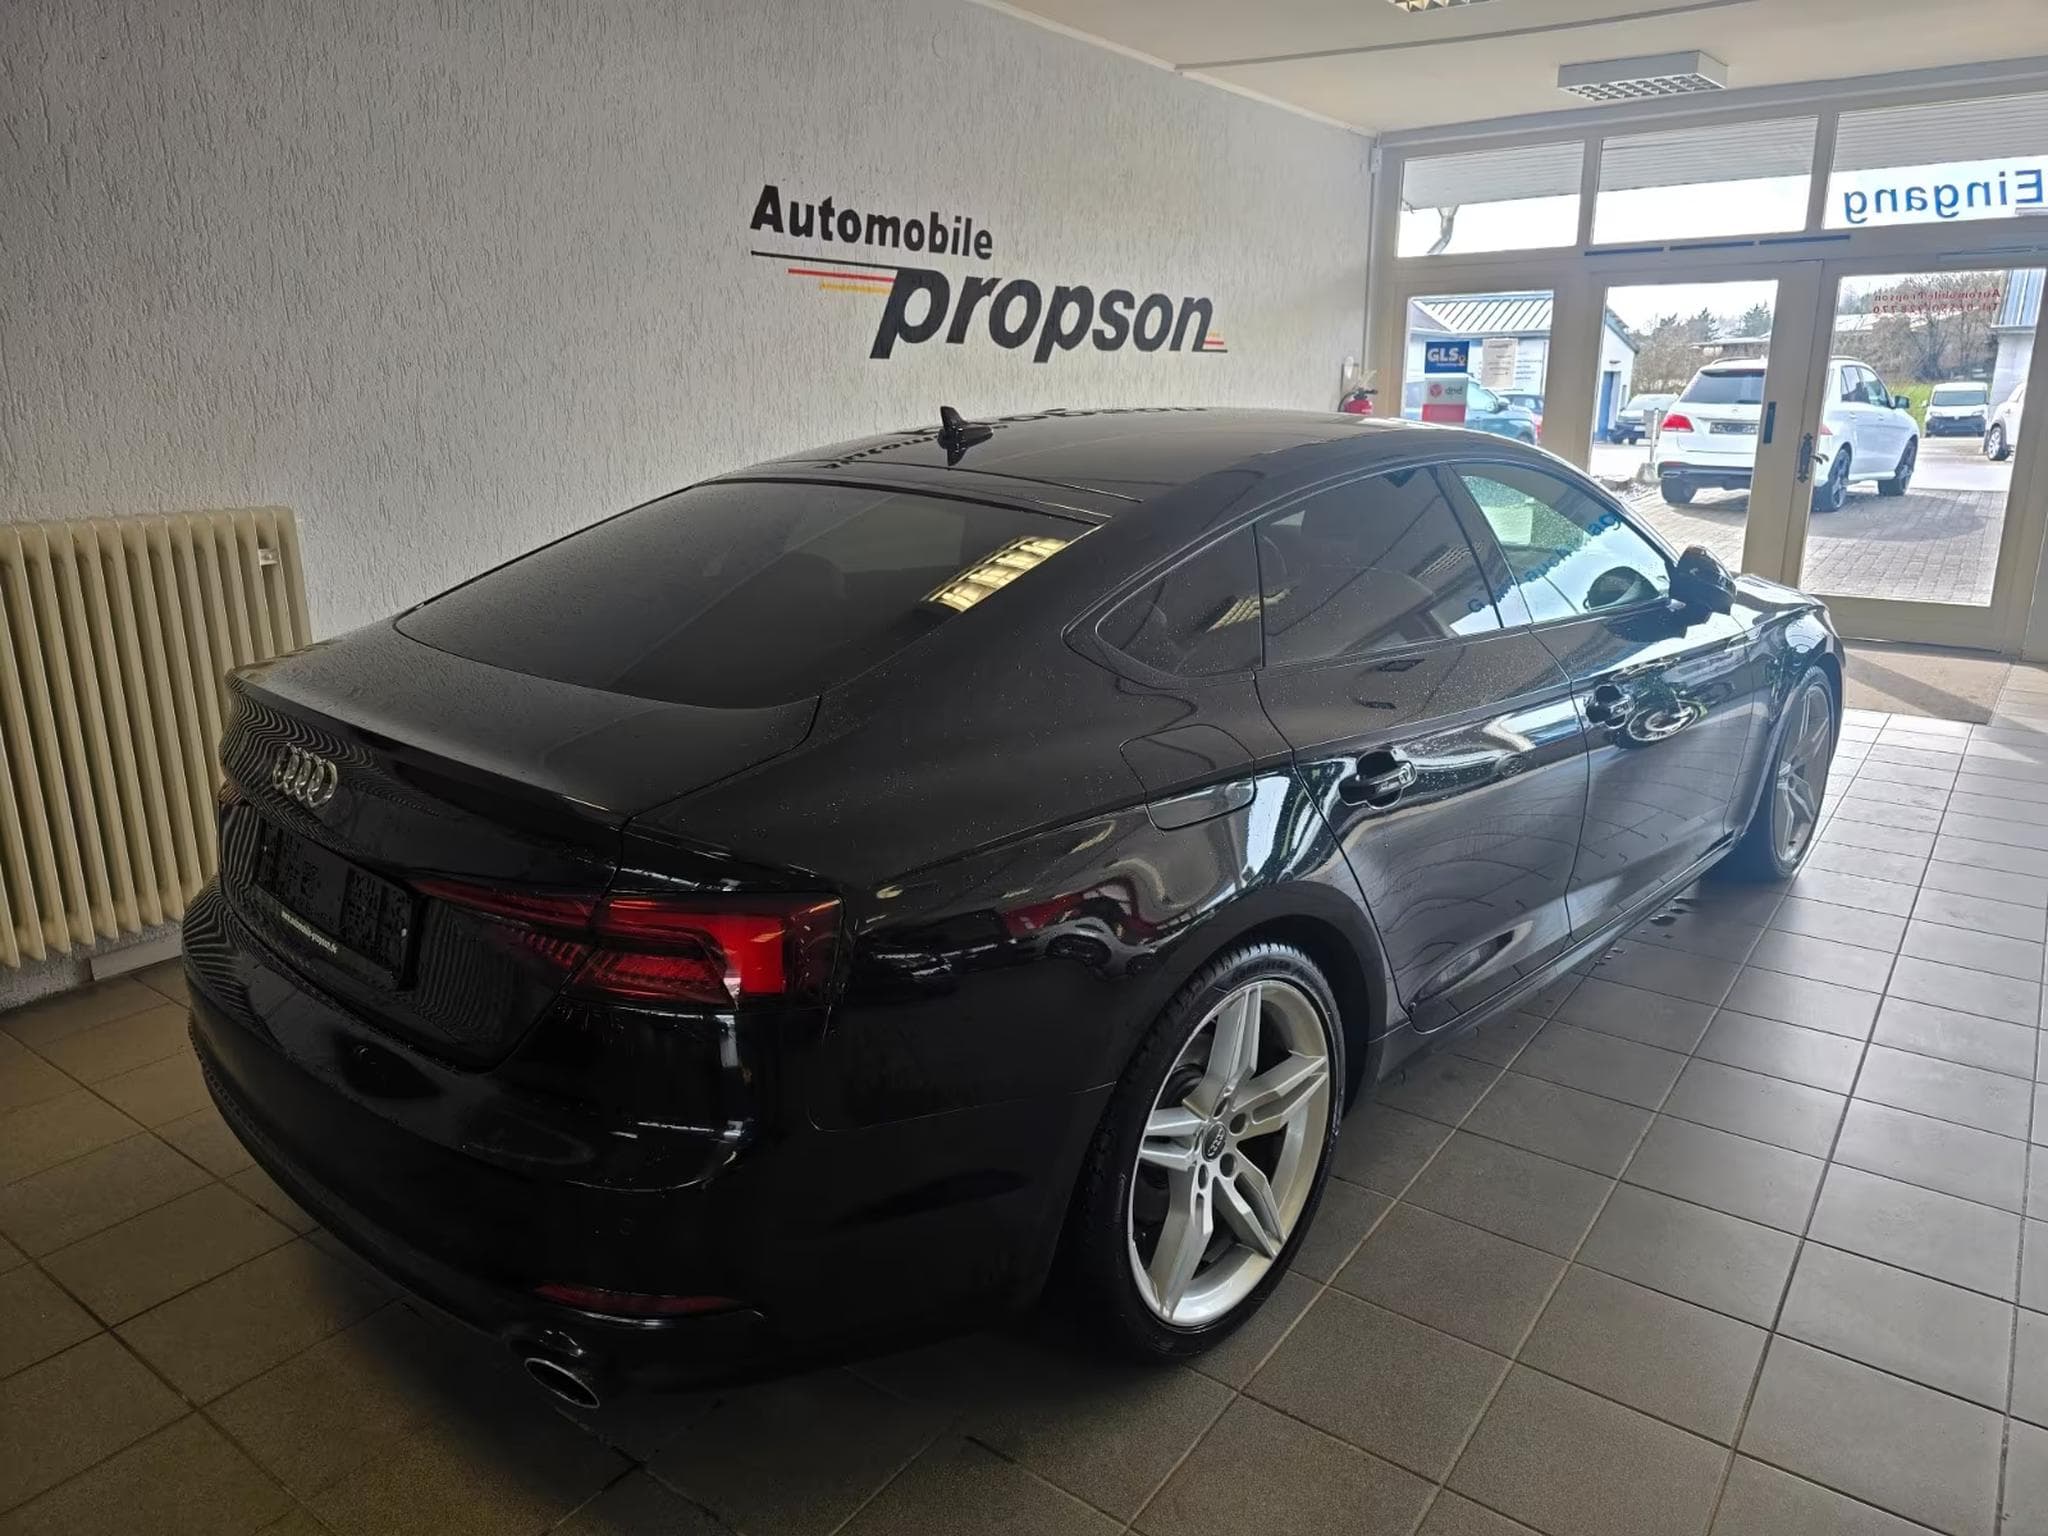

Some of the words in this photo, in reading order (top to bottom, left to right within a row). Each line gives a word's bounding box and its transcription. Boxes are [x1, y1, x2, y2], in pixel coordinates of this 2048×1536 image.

[750, 184, 993, 259] Automobile
[869, 267, 1214, 363] propson
[1427, 347, 1460, 362] GLS
